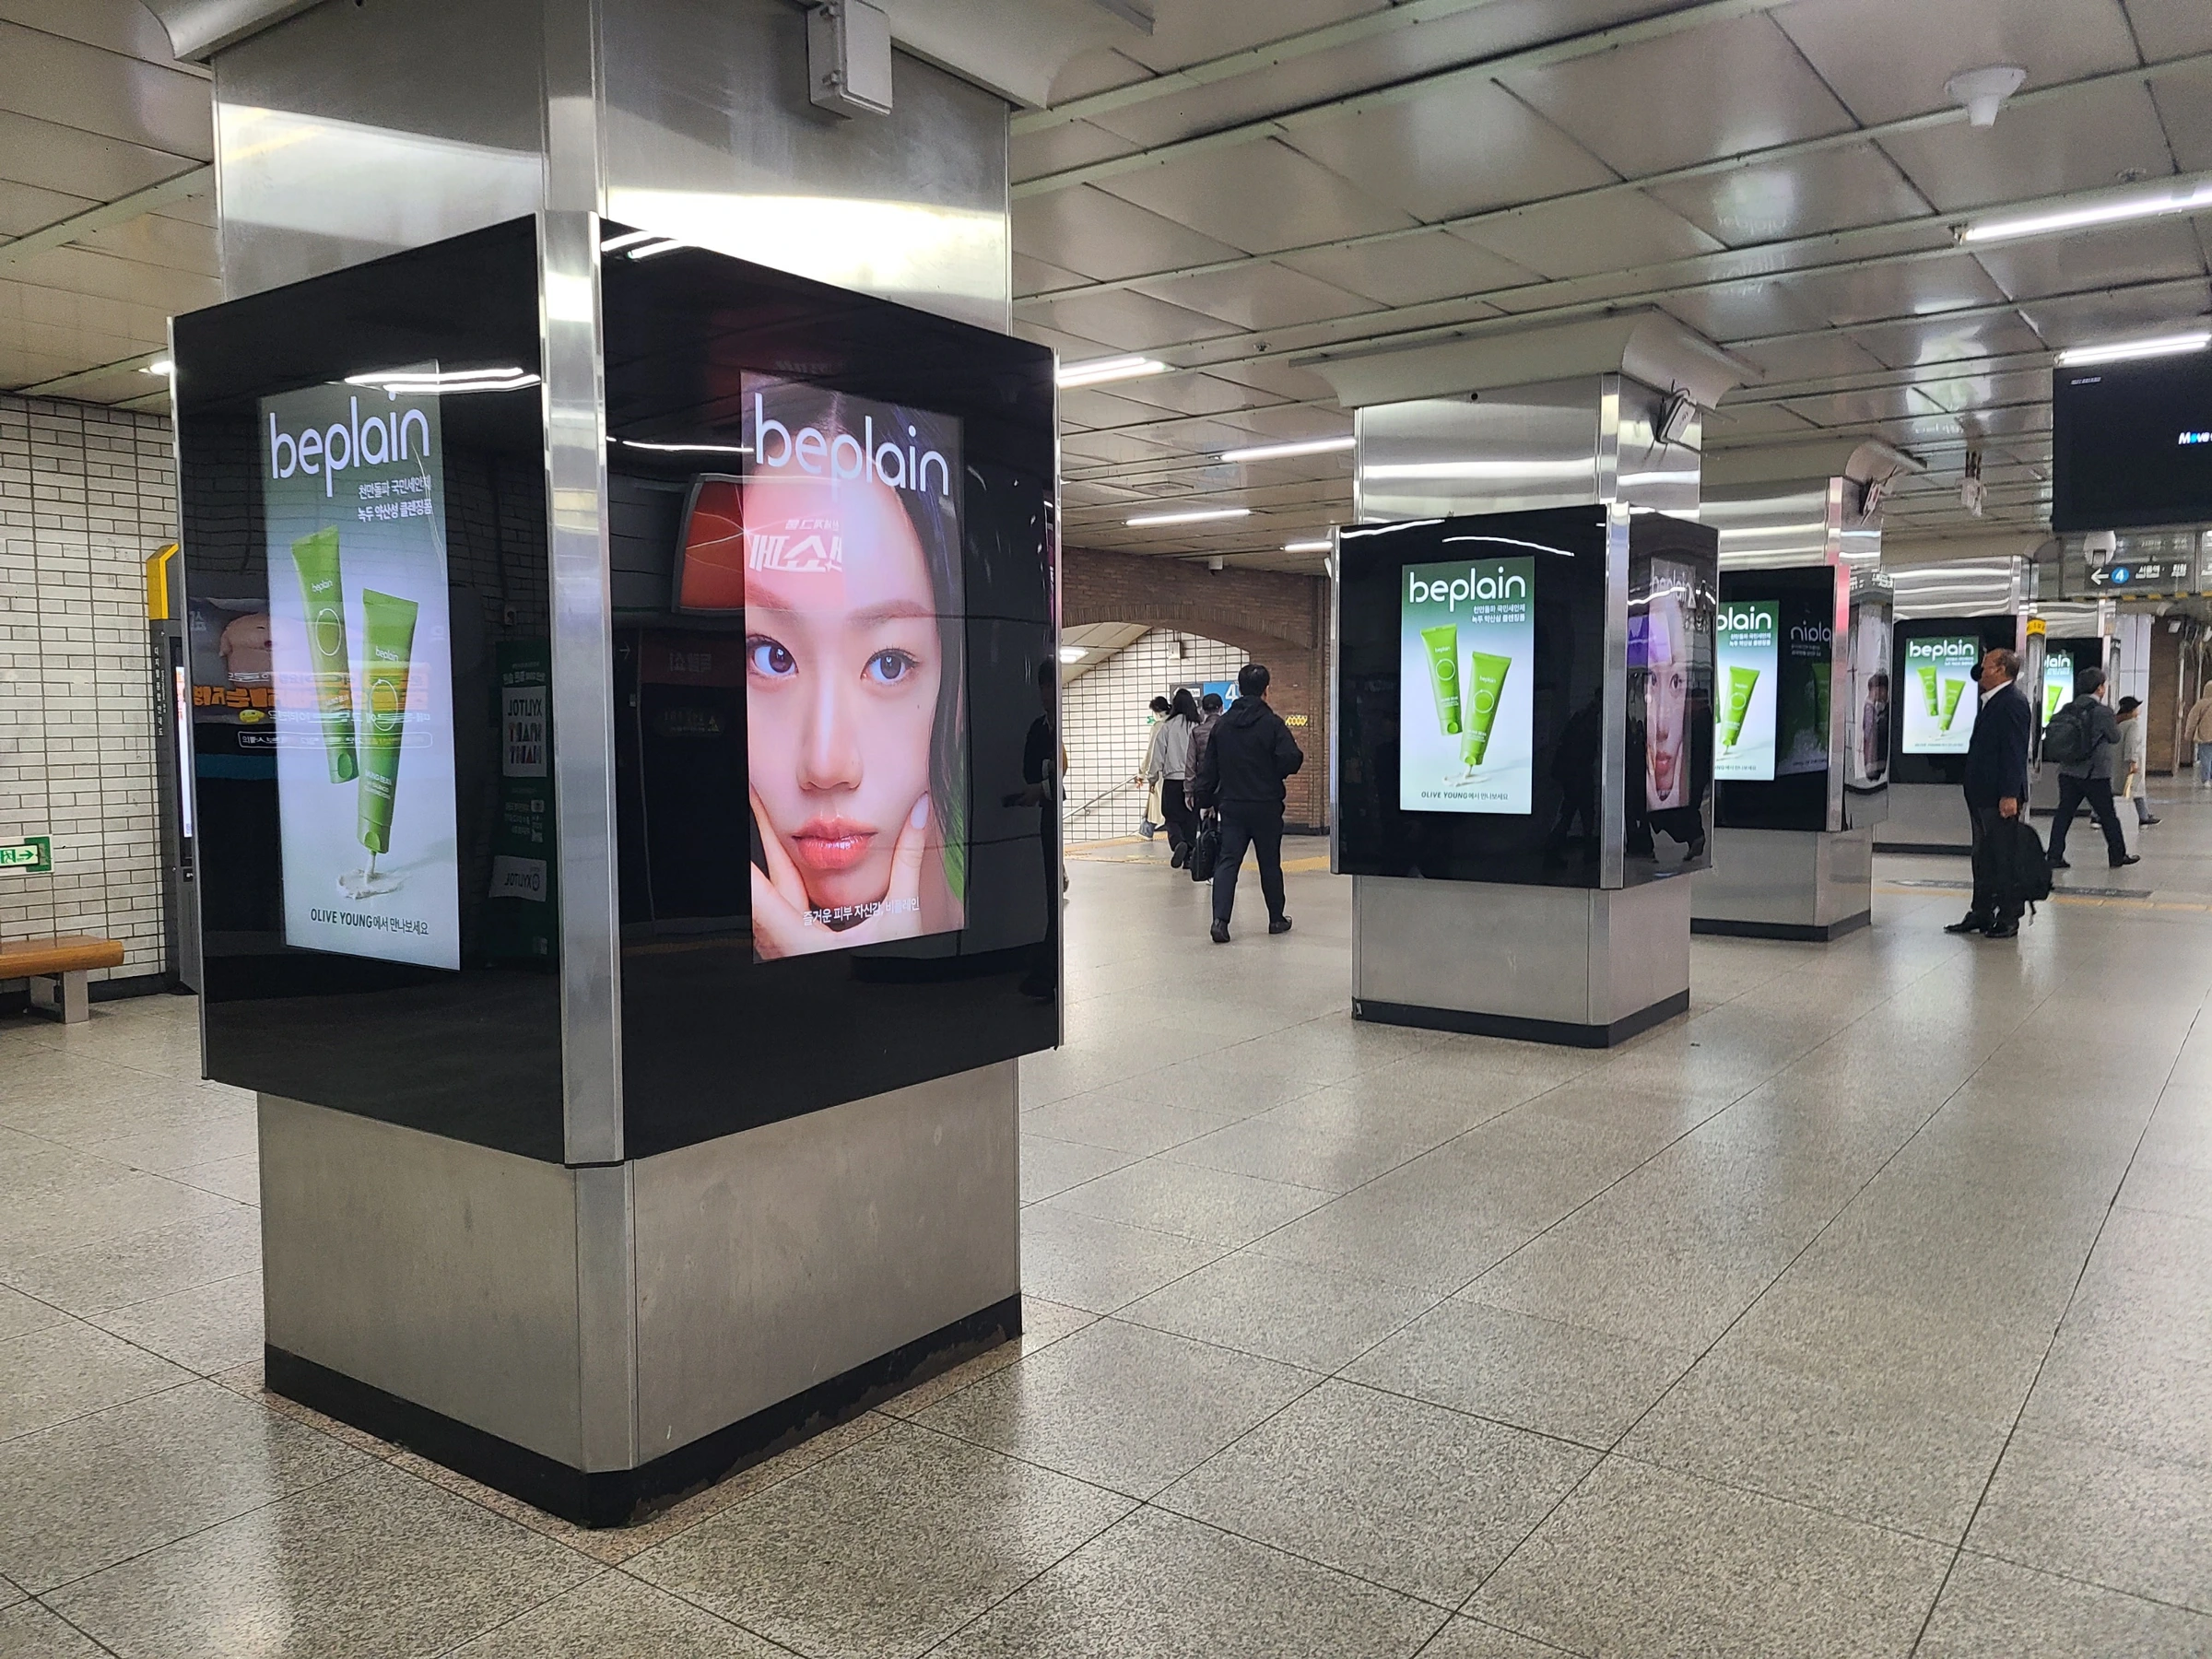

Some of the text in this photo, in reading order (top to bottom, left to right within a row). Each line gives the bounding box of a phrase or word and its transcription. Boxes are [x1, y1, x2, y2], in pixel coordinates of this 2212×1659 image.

[270, 391, 429, 498] beplain
[755, 393, 949, 502] beplain
[359, 474, 431, 500] 천만돌파 국민세안제
[358, 499, 432, 523] 녹두 약산성 클렌징폼
[312, 579, 334, 594] beplain
[2115, 569, 2124, 581] 4
[1409, 566, 1525, 612] beplain
[1717, 606, 1771, 631] plain
[1910, 639, 1974, 661] beplain
[2044, 653, 2070, 668] lain
[1225, 683, 1240, 701] 4
[1421, 791, 1441, 799] OLIVE
[311, 908, 429, 935] OLIVE YOUNG에서 만나보세요
[803, 908, 831, 925] 즐거운
[833, 906, 853, 921] 피부
